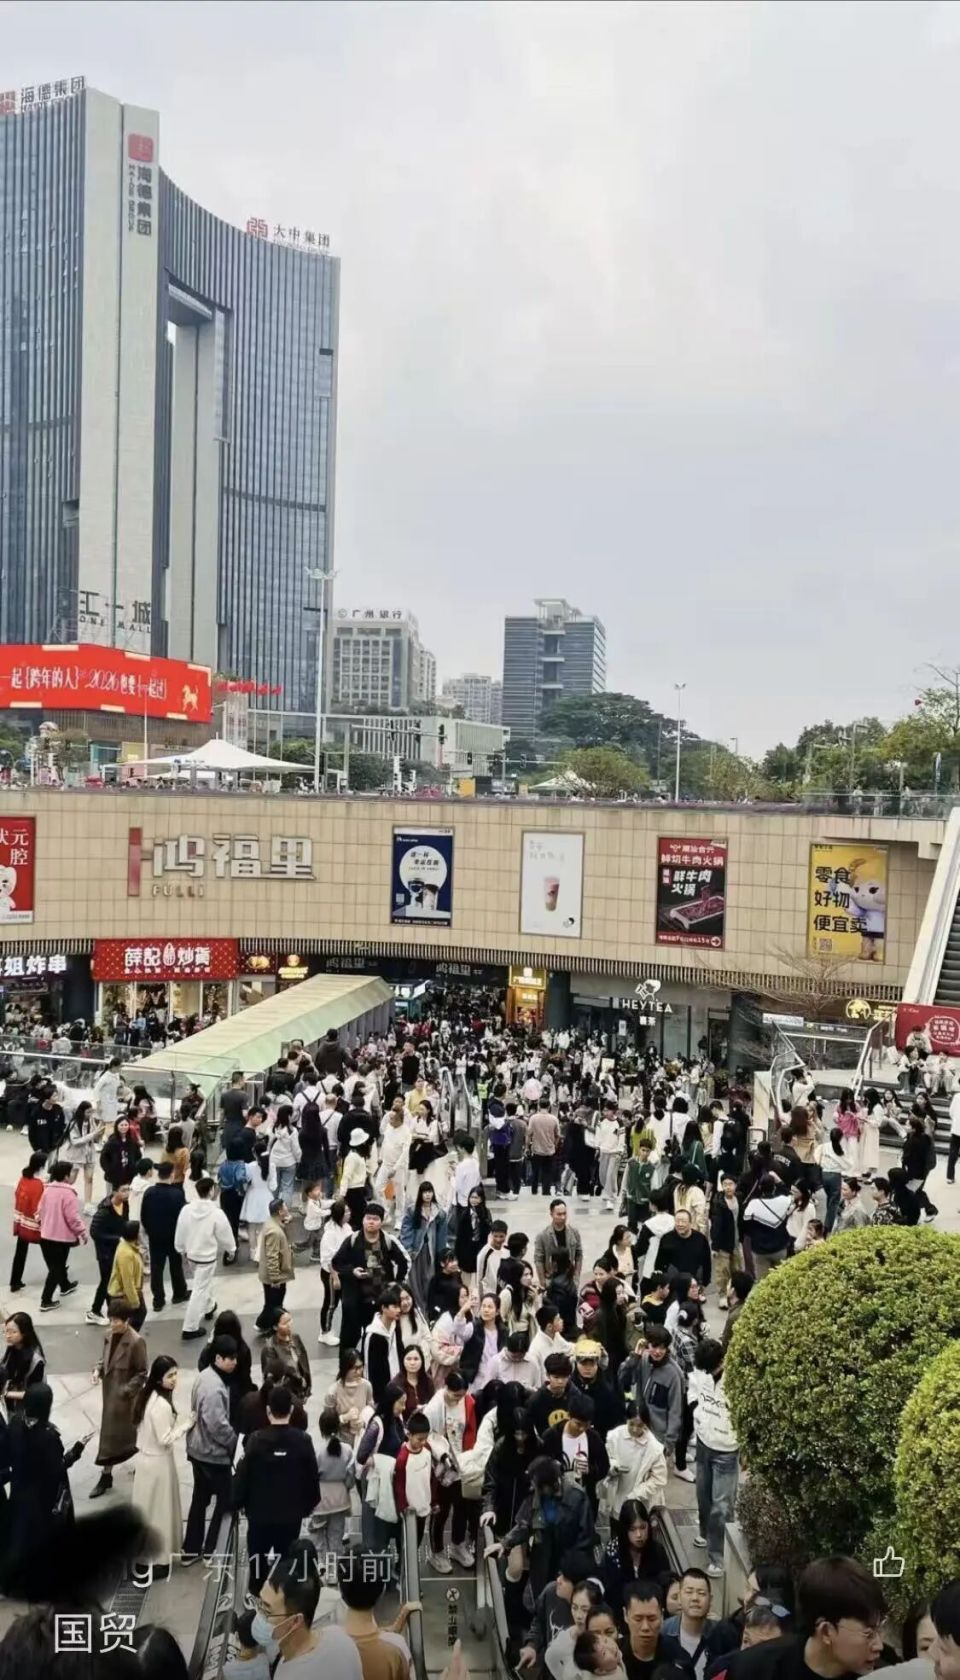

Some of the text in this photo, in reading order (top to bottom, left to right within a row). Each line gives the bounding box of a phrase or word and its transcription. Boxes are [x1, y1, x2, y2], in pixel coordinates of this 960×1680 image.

[21, 76, 85, 104] 海德集团
[137, 166, 152, 236] 海德集团
[273, 224, 330, 247] 大中集团
[352, 609, 402, 619] 广州银行
[79, 615, 151, 634] ONE MALL
[10, 848, 29, 865] 腔
[152, 832, 316, 880] 鸿福里
[815, 866, 851, 884] 零食
[814, 890, 850, 909] 好物
[813, 914, 868, 934] 便宜卖
[0, 954, 67, 977] 姐炸串
[435, 963, 471, 976] 鸿福里
[622, 998, 673, 1013] HEYTEA
